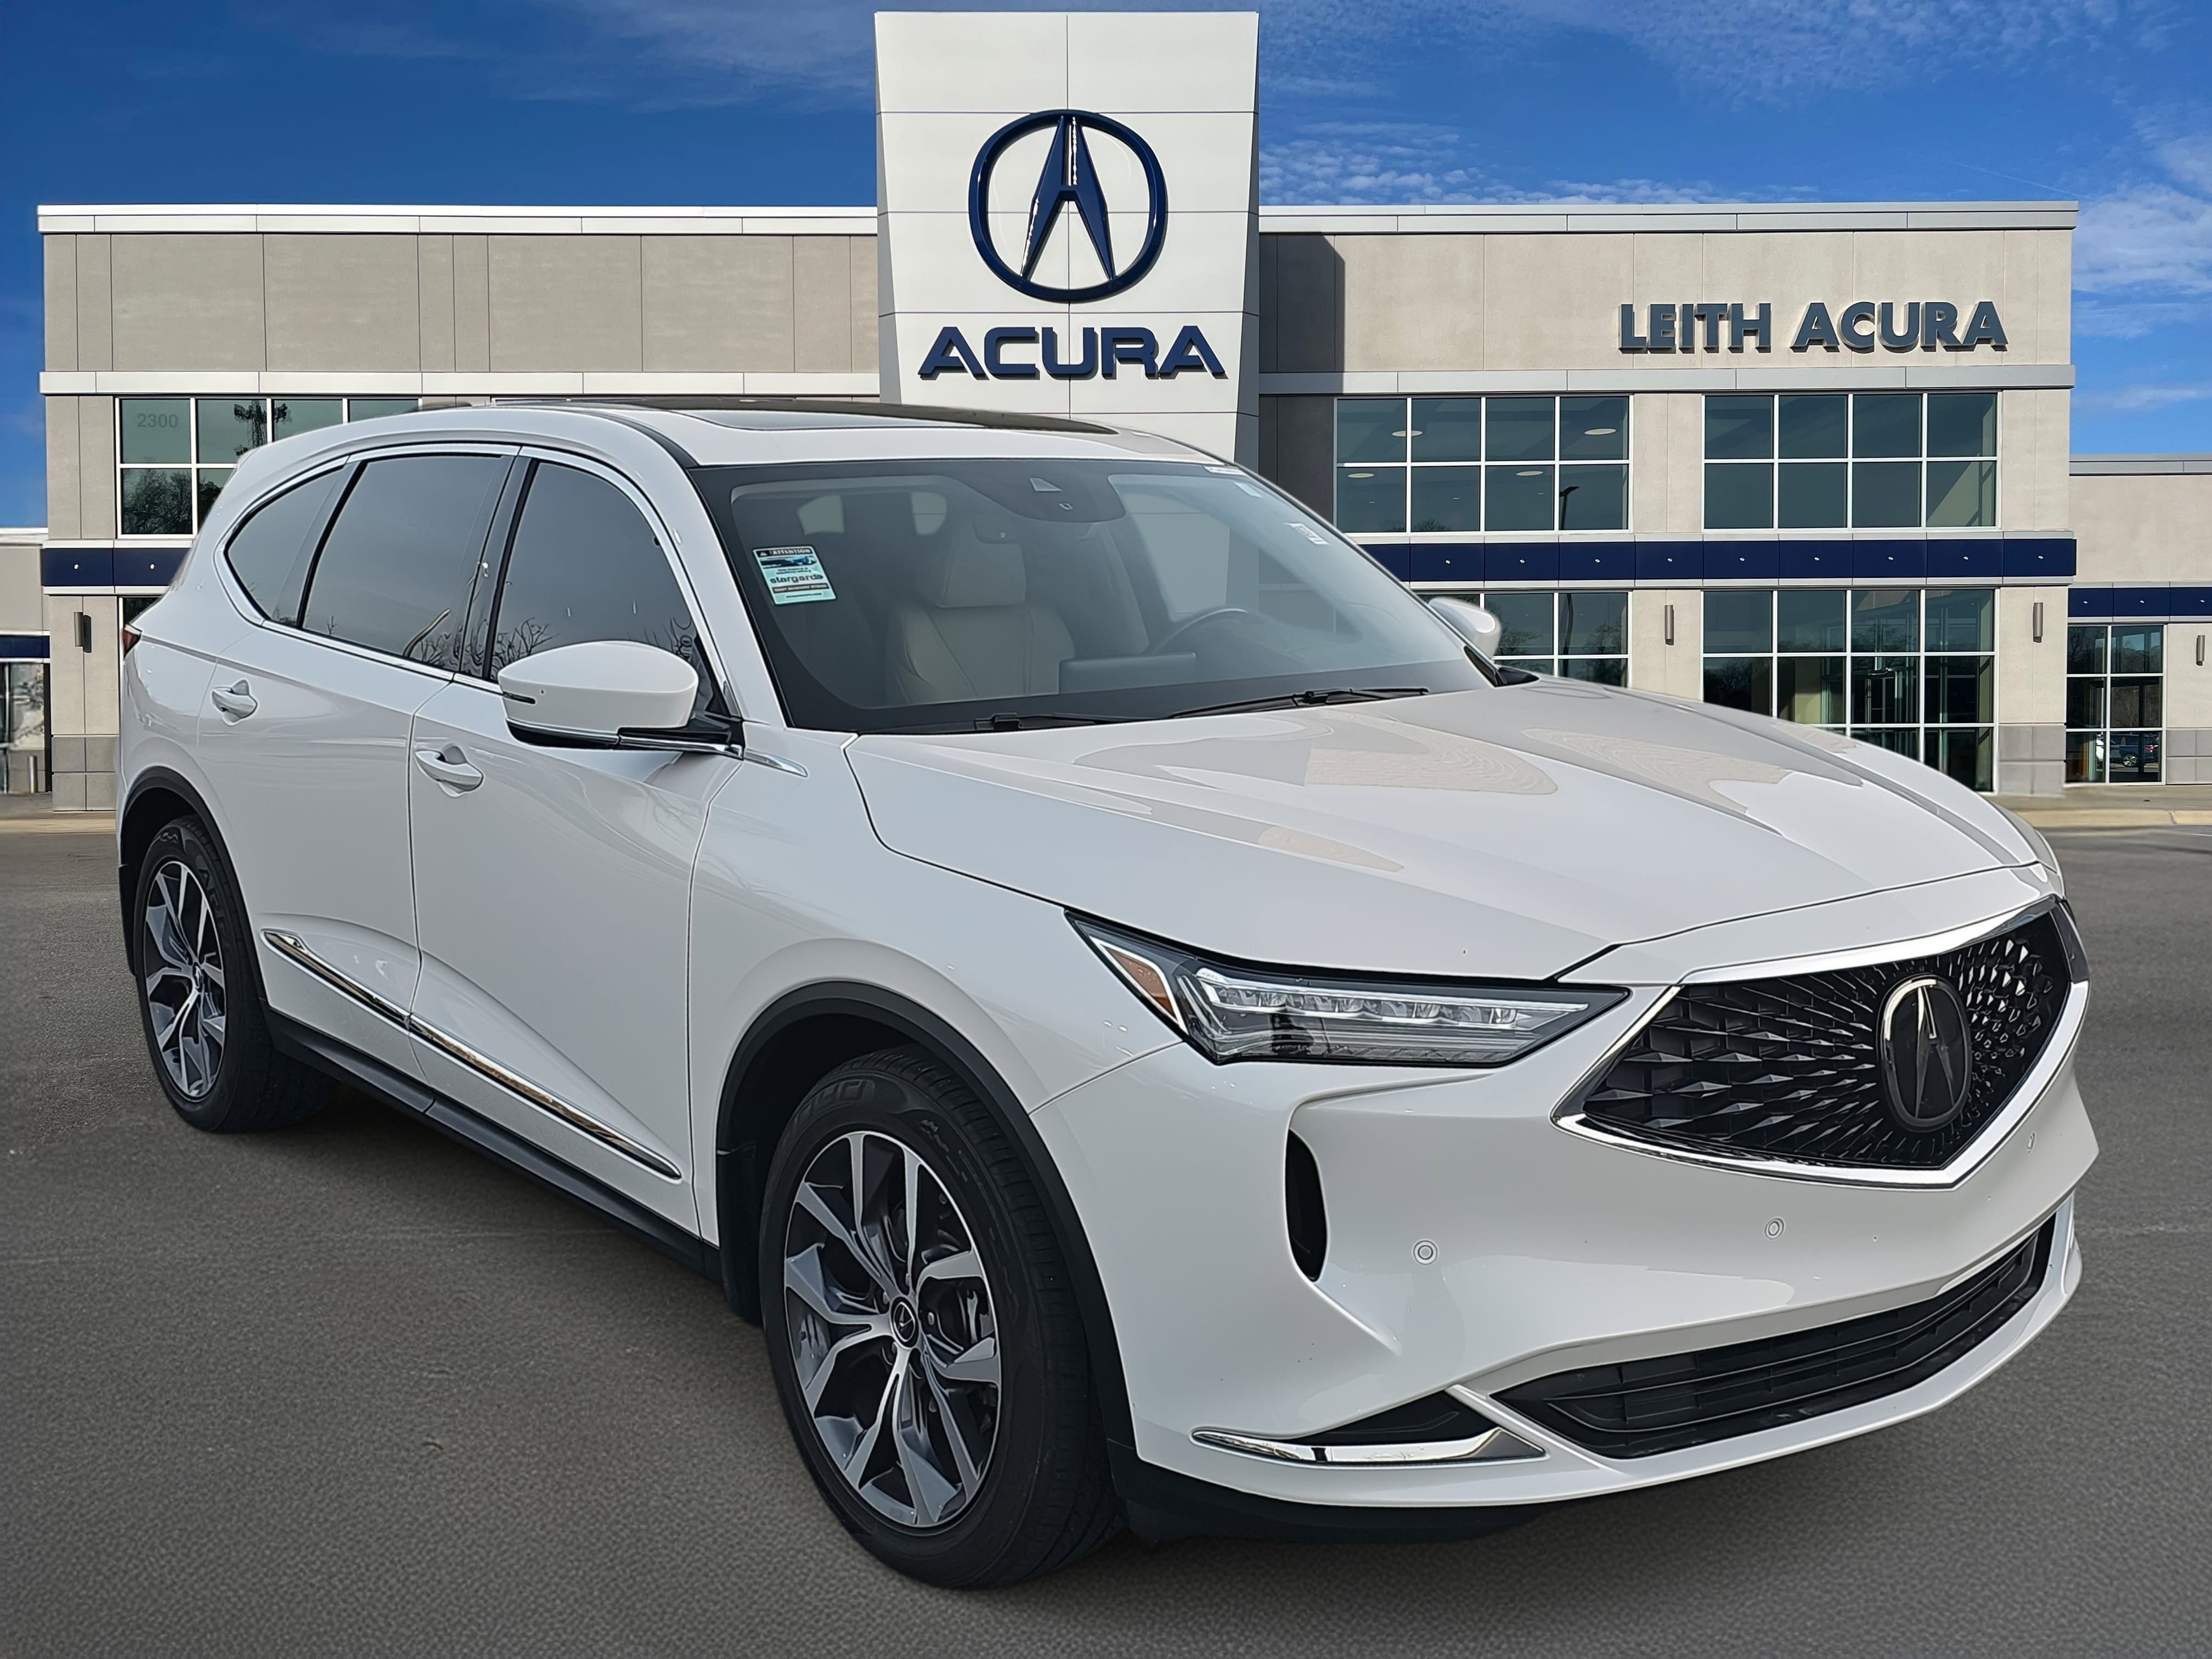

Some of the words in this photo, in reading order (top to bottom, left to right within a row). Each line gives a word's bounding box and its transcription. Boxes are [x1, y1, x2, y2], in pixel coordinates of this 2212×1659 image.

[1619, 303, 1771, 352] LEITH
[1790, 301, 2009, 352] ACURA
[918, 326, 1226, 379] ACURA
[137, 413, 178, 428] 2300
